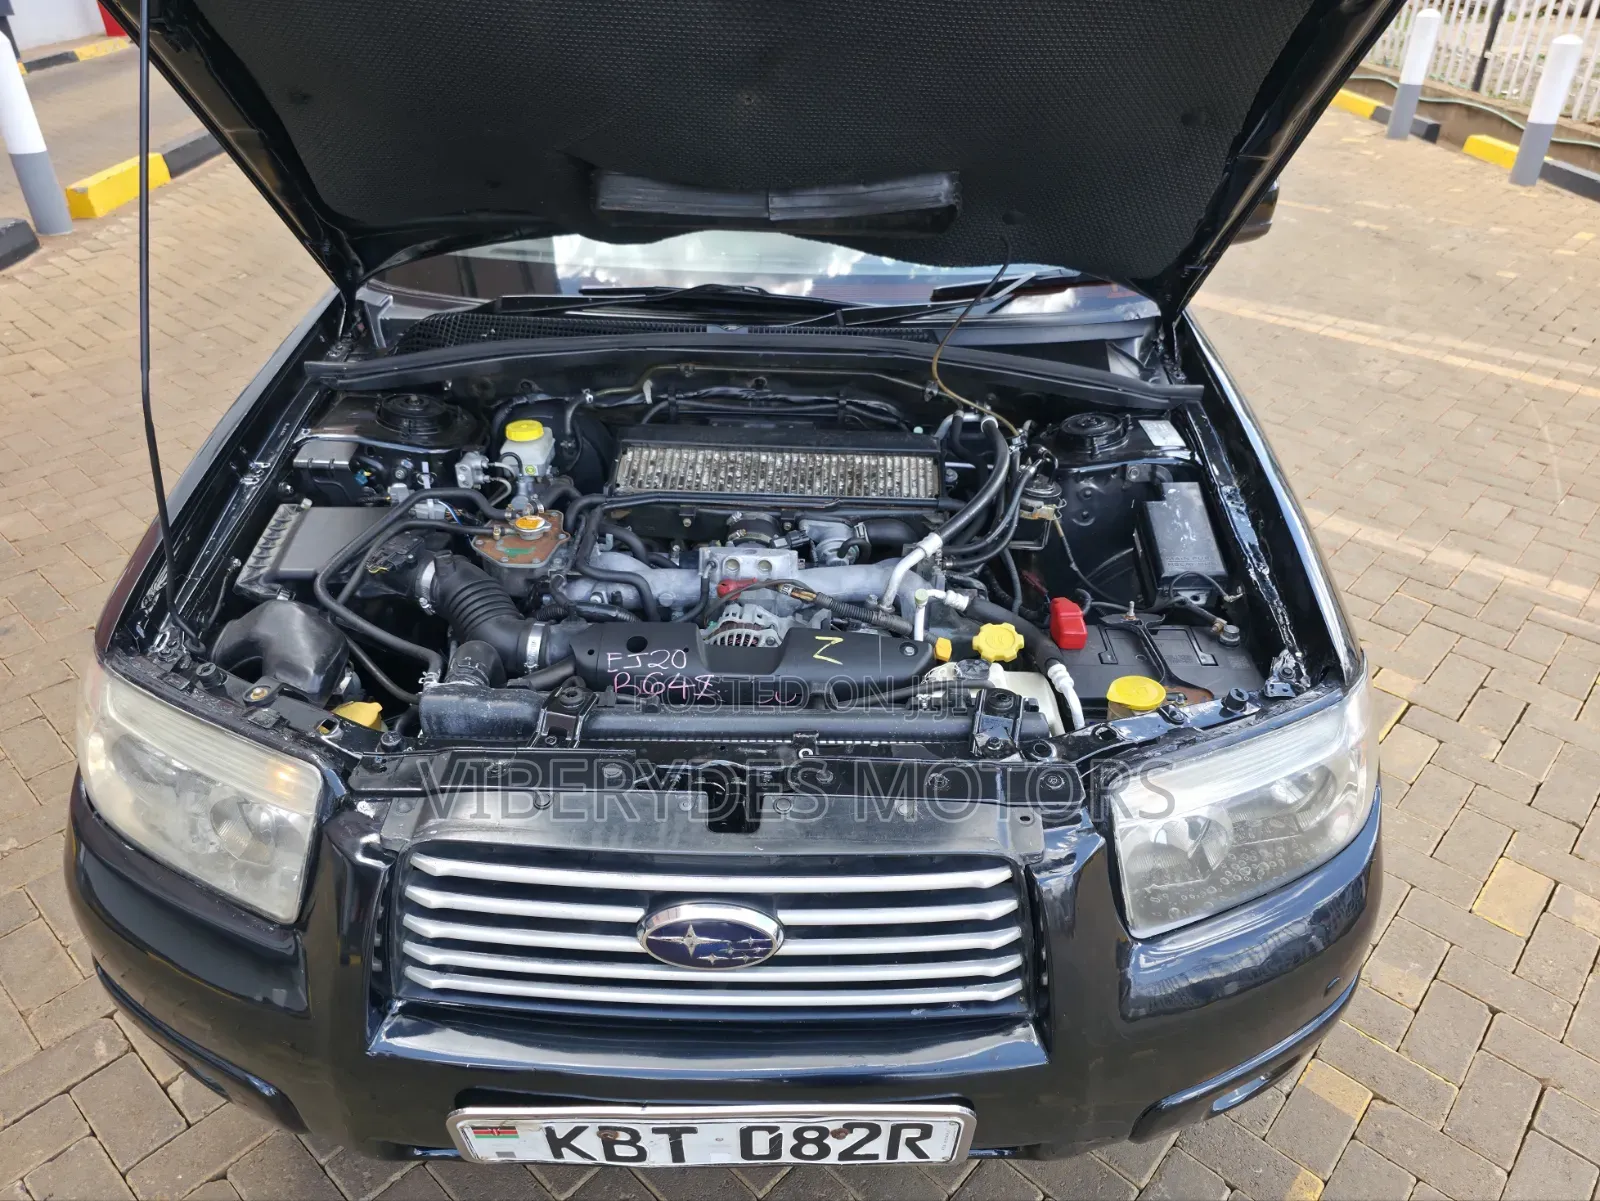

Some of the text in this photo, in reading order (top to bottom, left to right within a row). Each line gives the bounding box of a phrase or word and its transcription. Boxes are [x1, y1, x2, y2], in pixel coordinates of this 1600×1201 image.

[606, 649, 687, 673] EJ20
[545, 1124, 699, 1164] KBT
[739, 1121, 934, 1162] 082R
